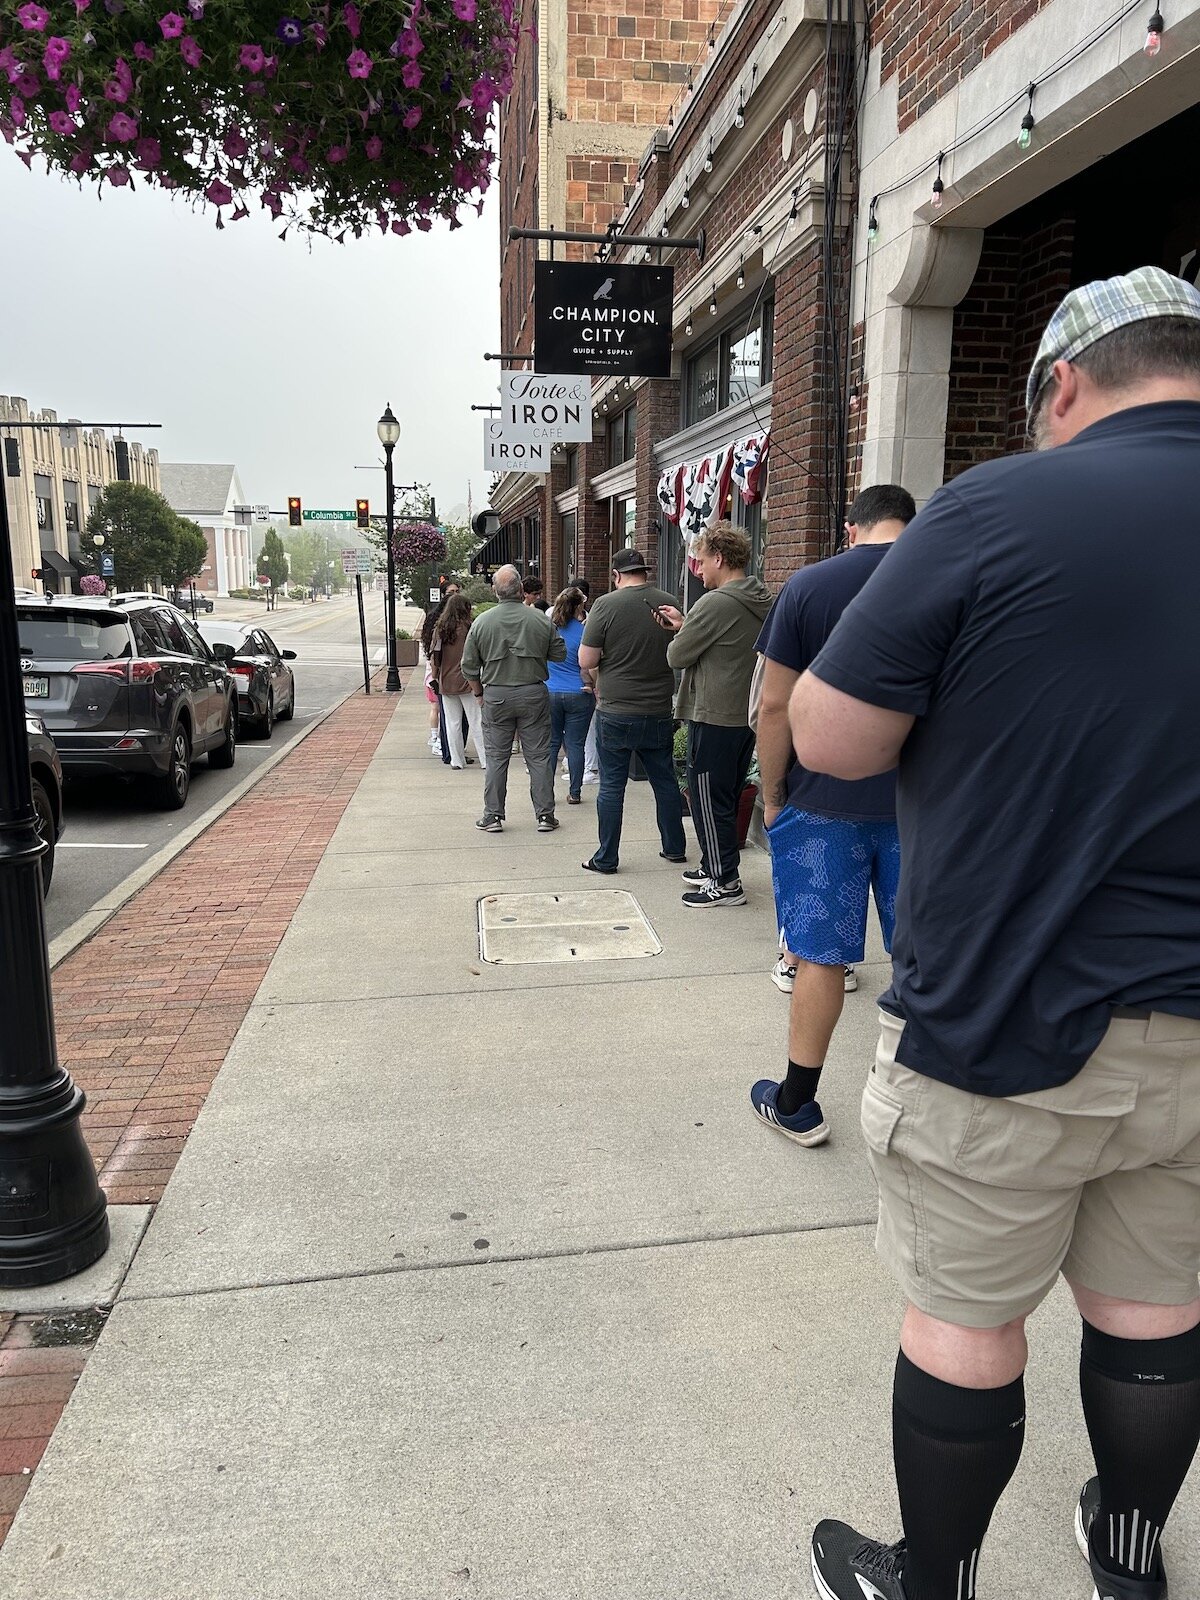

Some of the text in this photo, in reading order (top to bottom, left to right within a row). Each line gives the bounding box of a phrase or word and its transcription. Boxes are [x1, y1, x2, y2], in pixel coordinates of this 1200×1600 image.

[581, 328, 625, 343] CITY
[573, 347, 596, 355] GUIDE
[607, 348, 634, 356] SUPPLY
[509, 374, 567, 399] Torte
[511, 404, 580, 424] IRON
[532, 426, 563, 438] CAFÉ
[491, 443, 542, 458] IRON
[310, 510, 344, 520] Columbia
